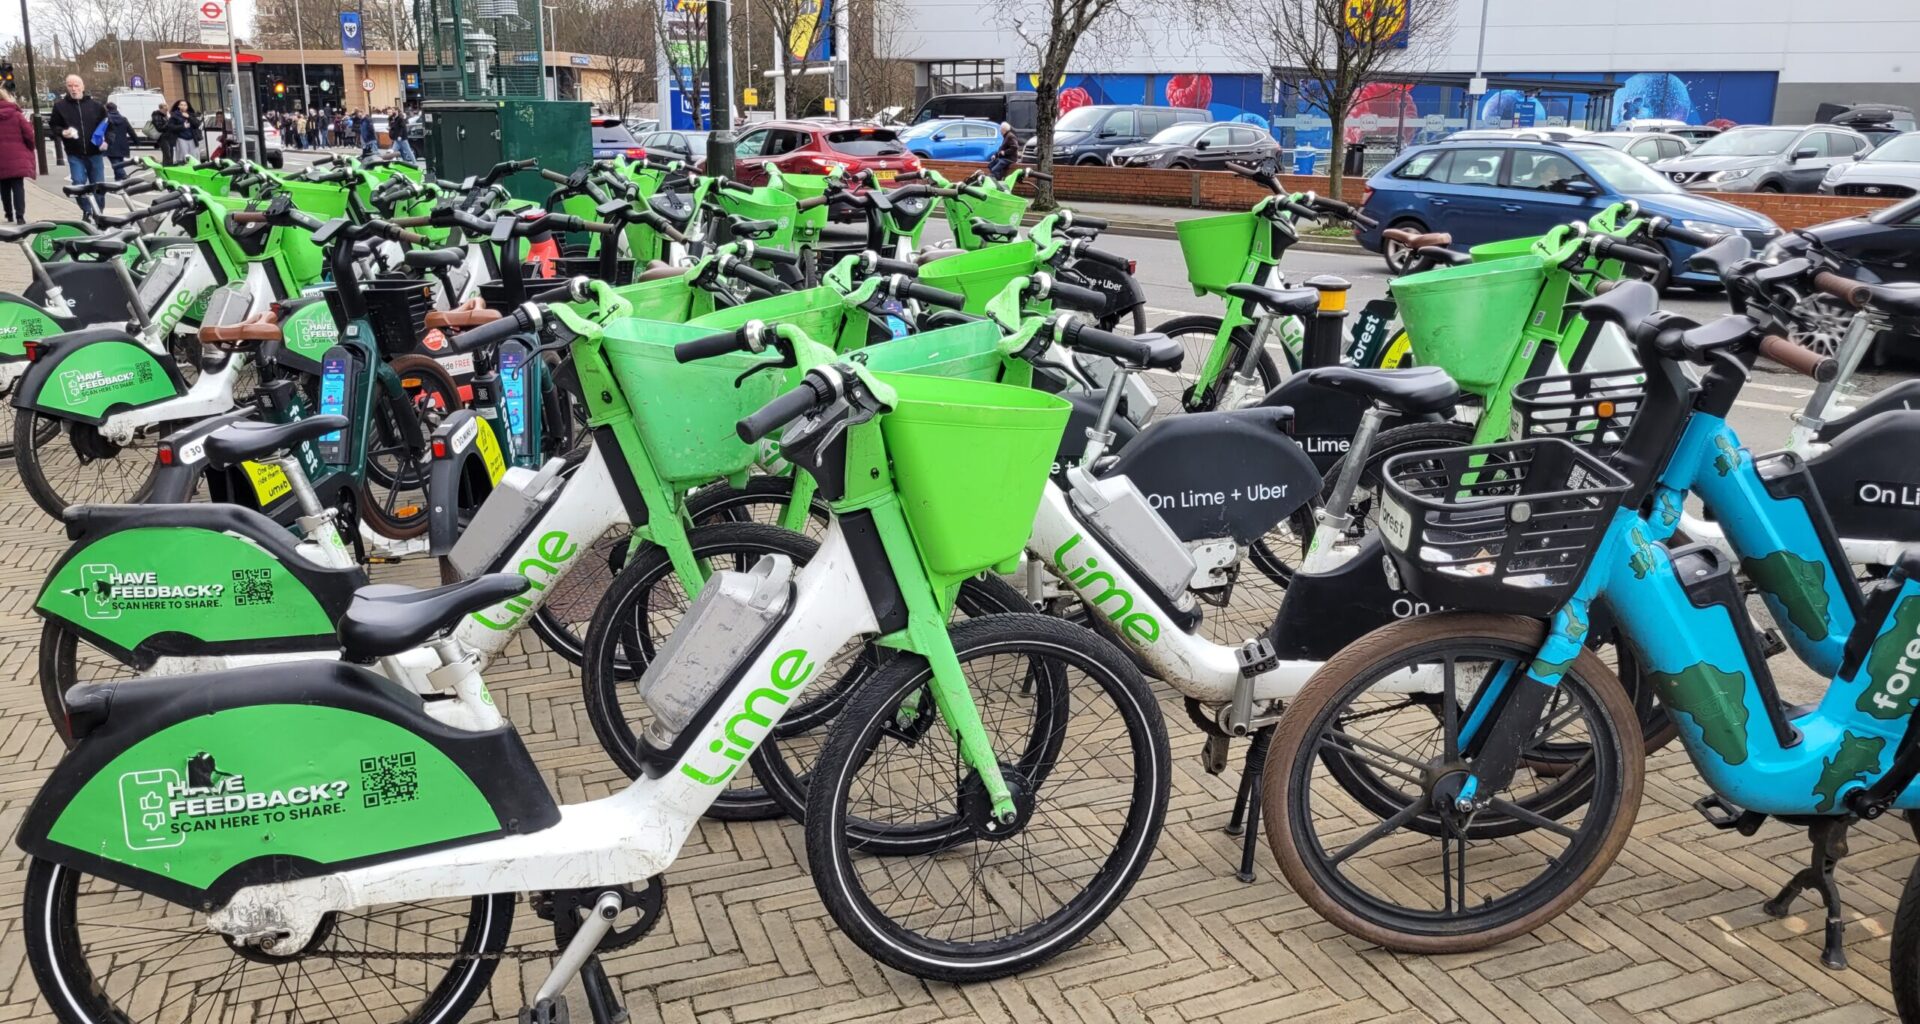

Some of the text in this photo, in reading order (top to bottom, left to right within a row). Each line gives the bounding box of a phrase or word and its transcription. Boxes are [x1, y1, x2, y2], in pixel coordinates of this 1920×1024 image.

[1103, 279, 1122, 292] Uber
[309, 323, 334, 331] HAVE
[1349, 314, 1380, 367] forest
[454, 358, 471, 369] FREE
[77, 370, 104, 383] HAVE
[79, 371, 134, 391] FEEDBACK?
[81, 389, 98, 397] SCAN
[190, 445, 202, 456] 30
[1307, 437, 1350, 453] Lime
[1147, 484, 1288, 510] On Lime + Uber
[1860, 483, 1920, 506] On Li
[1382, 502, 1405, 538] orest
[109, 572, 157, 586] HAVE
[471, 530, 578, 631] Lime
[110, 584, 225, 600] FEEDBACK?
[1054, 533, 1160, 646] Lime
[111, 599, 224, 611] SCAN HERE TO SHARE.
[1392, 598, 1430, 618] On
[1873, 622, 1920, 710] fore
[680, 648, 816, 786] Lime
[169, 780, 350, 820] FEEDBACK?
[170, 802, 347, 834] SCAN HERE TO SHARE.
